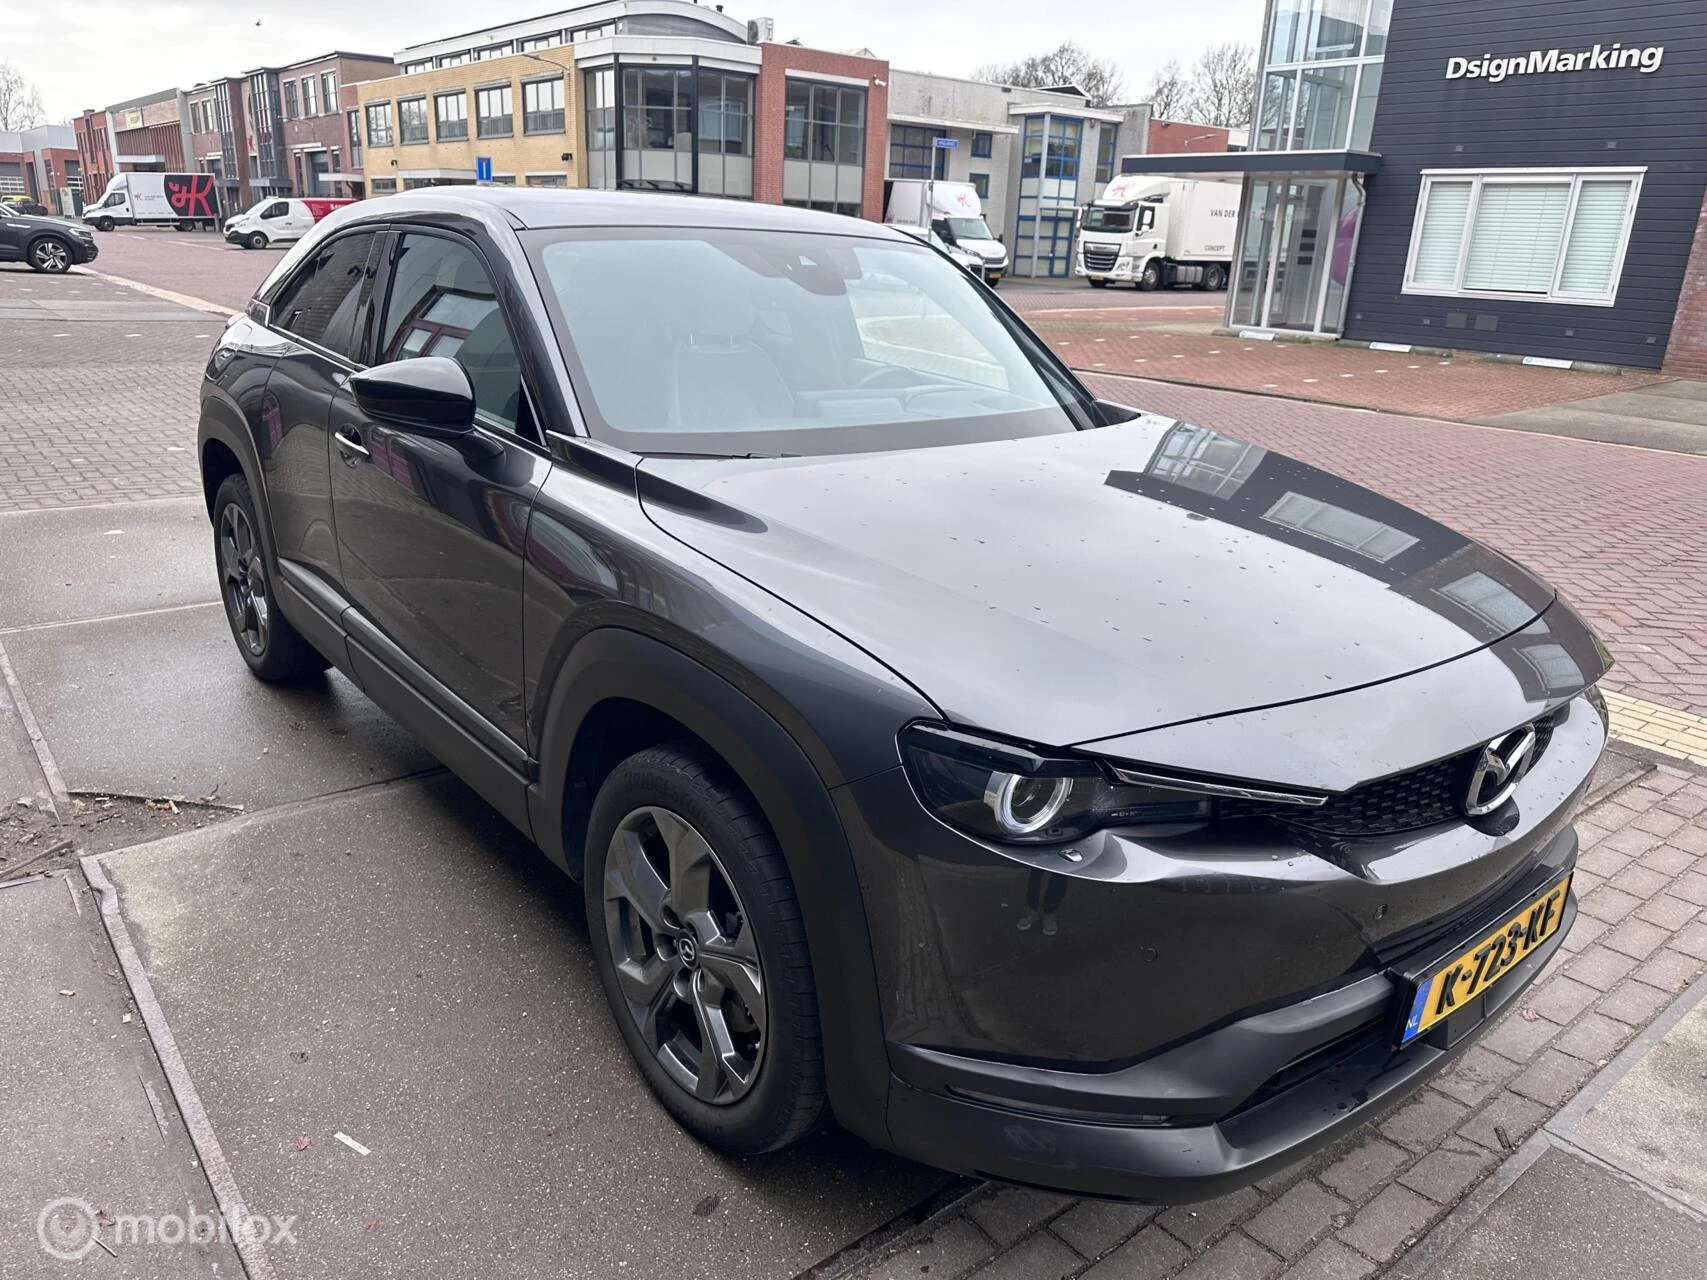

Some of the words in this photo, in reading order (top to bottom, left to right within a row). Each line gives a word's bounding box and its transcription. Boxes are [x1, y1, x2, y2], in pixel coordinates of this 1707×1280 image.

[1446, 43, 1664, 82] DsignMarking
[1210, 209, 1223, 217] VAN
[1223, 209, 1236, 218] DER
[1435, 890, 1561, 1015] K-723-KF
[1406, 1013, 1418, 1029] NL
